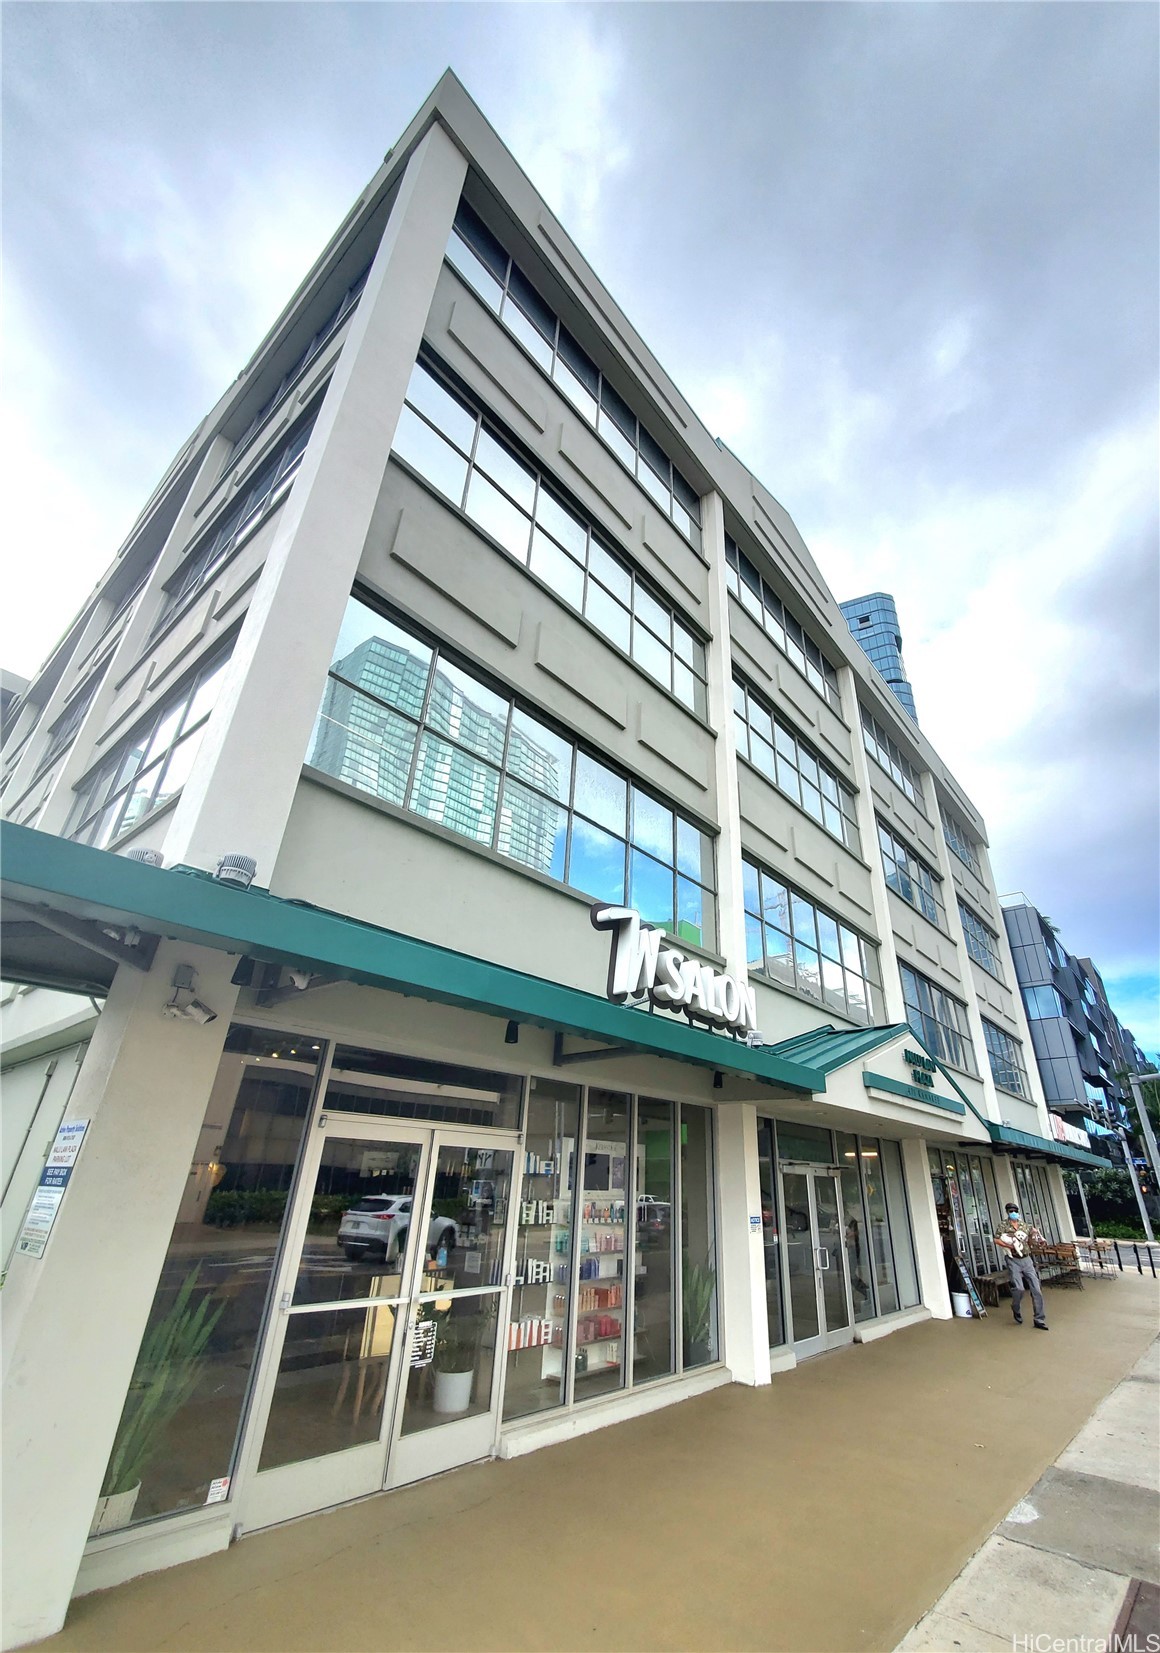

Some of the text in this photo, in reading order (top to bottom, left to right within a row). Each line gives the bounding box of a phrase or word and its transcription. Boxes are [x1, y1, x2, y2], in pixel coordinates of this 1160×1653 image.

[653, 949, 757, 1031] SALON
[46, 1168, 55, 1176] SEE
[44, 1177, 53, 1185] FOR
